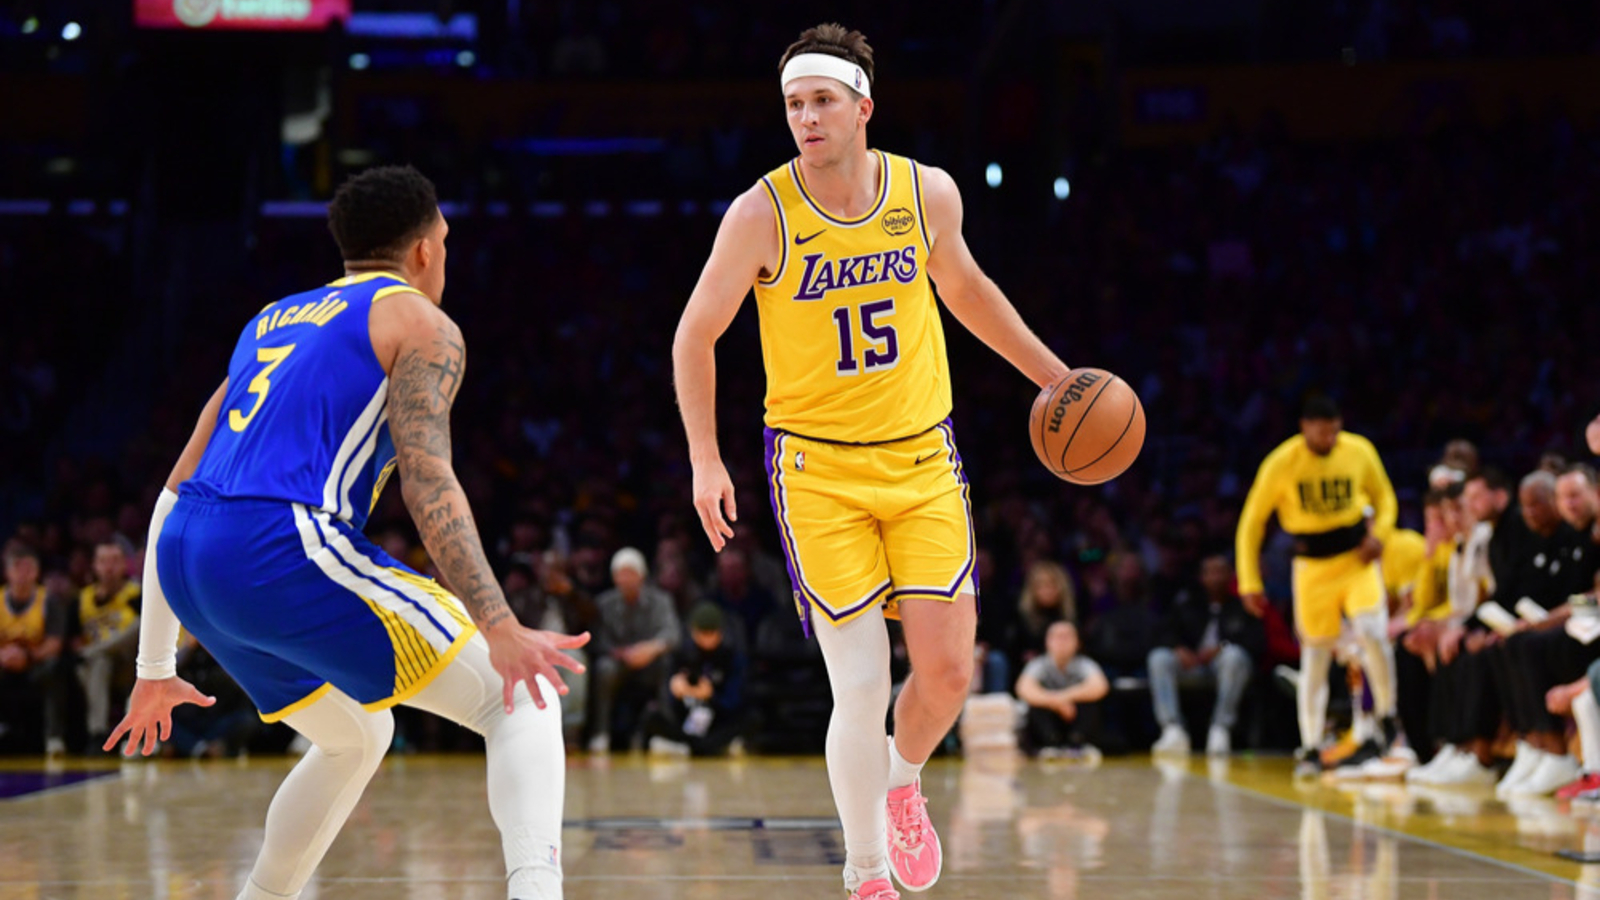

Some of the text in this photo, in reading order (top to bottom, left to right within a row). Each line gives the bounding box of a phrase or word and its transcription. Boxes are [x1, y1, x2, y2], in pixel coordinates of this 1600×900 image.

[884, 214, 913, 227] bibigo
[792, 245, 918, 301] LAKERS
[832, 297, 901, 377] 15
[228, 343, 297, 433] 3
[1047, 372, 1102, 434] Wilson
